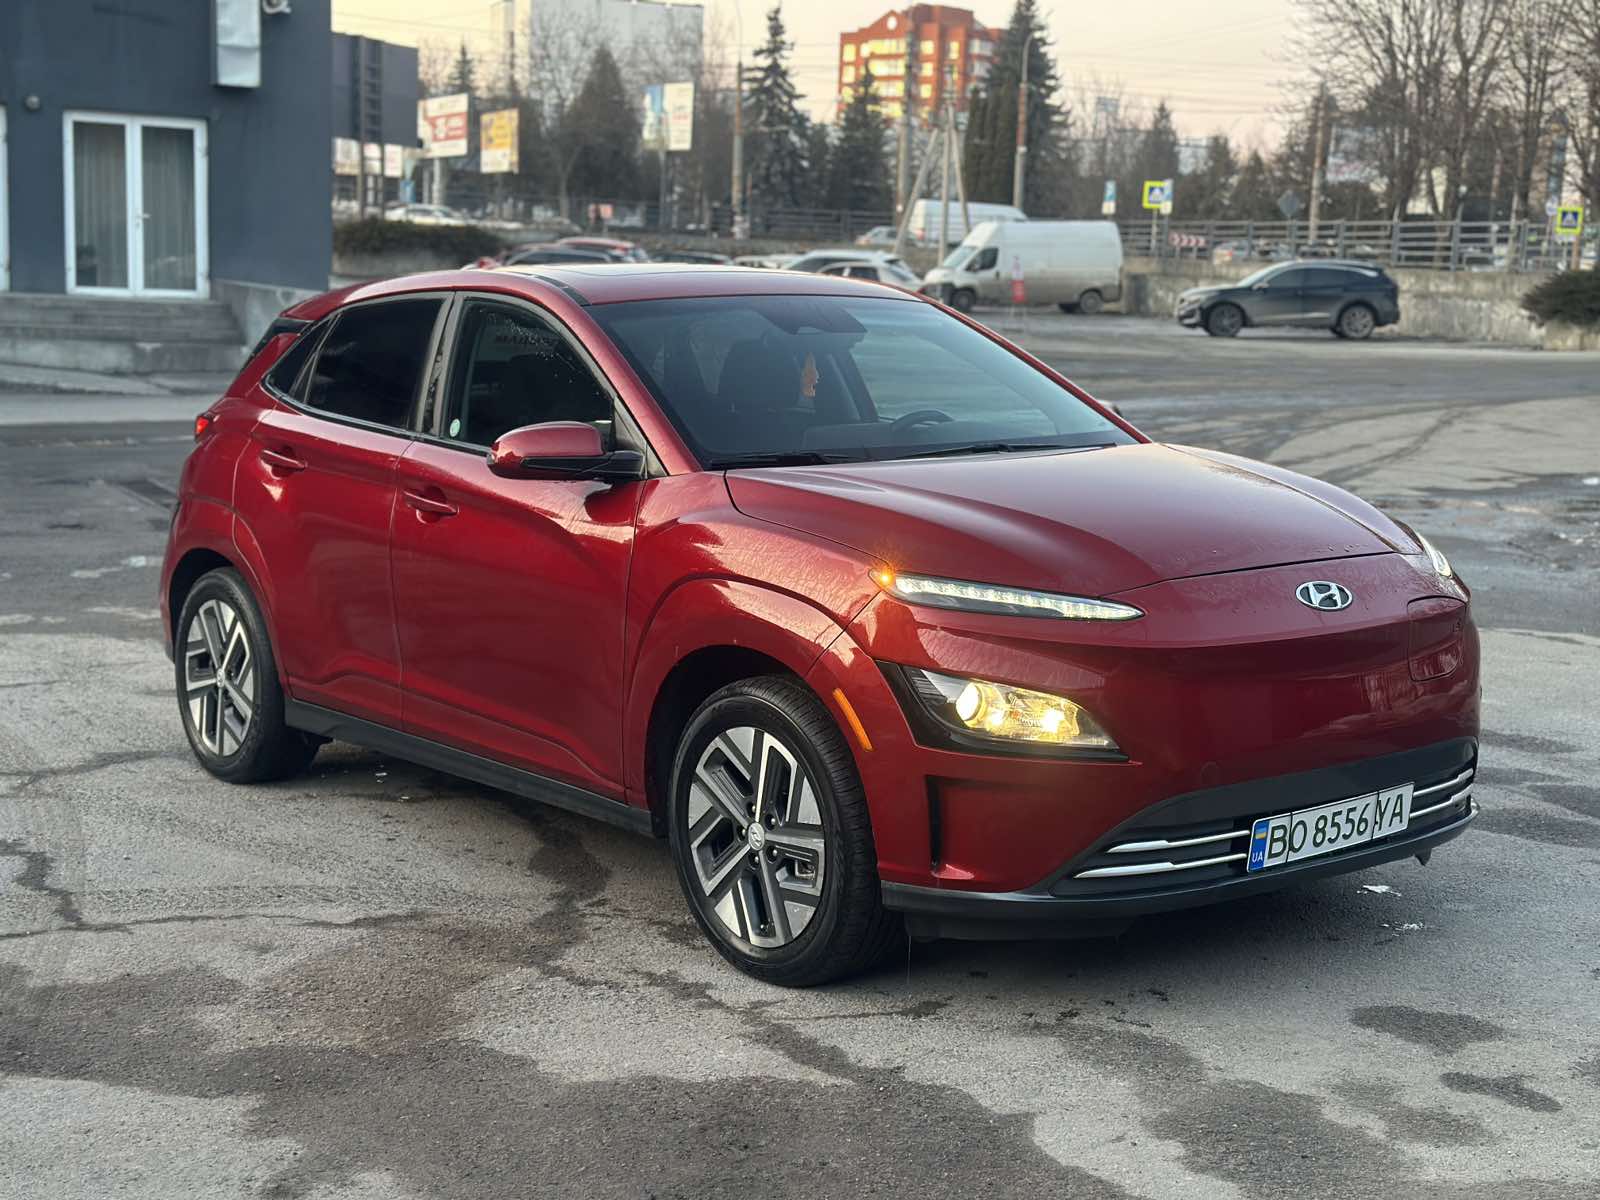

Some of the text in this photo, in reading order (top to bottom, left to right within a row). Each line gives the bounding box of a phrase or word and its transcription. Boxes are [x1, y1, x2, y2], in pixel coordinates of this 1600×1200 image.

[1267, 793, 1404, 860] BO 8556 YA
[1251, 850, 1264, 863] UA
